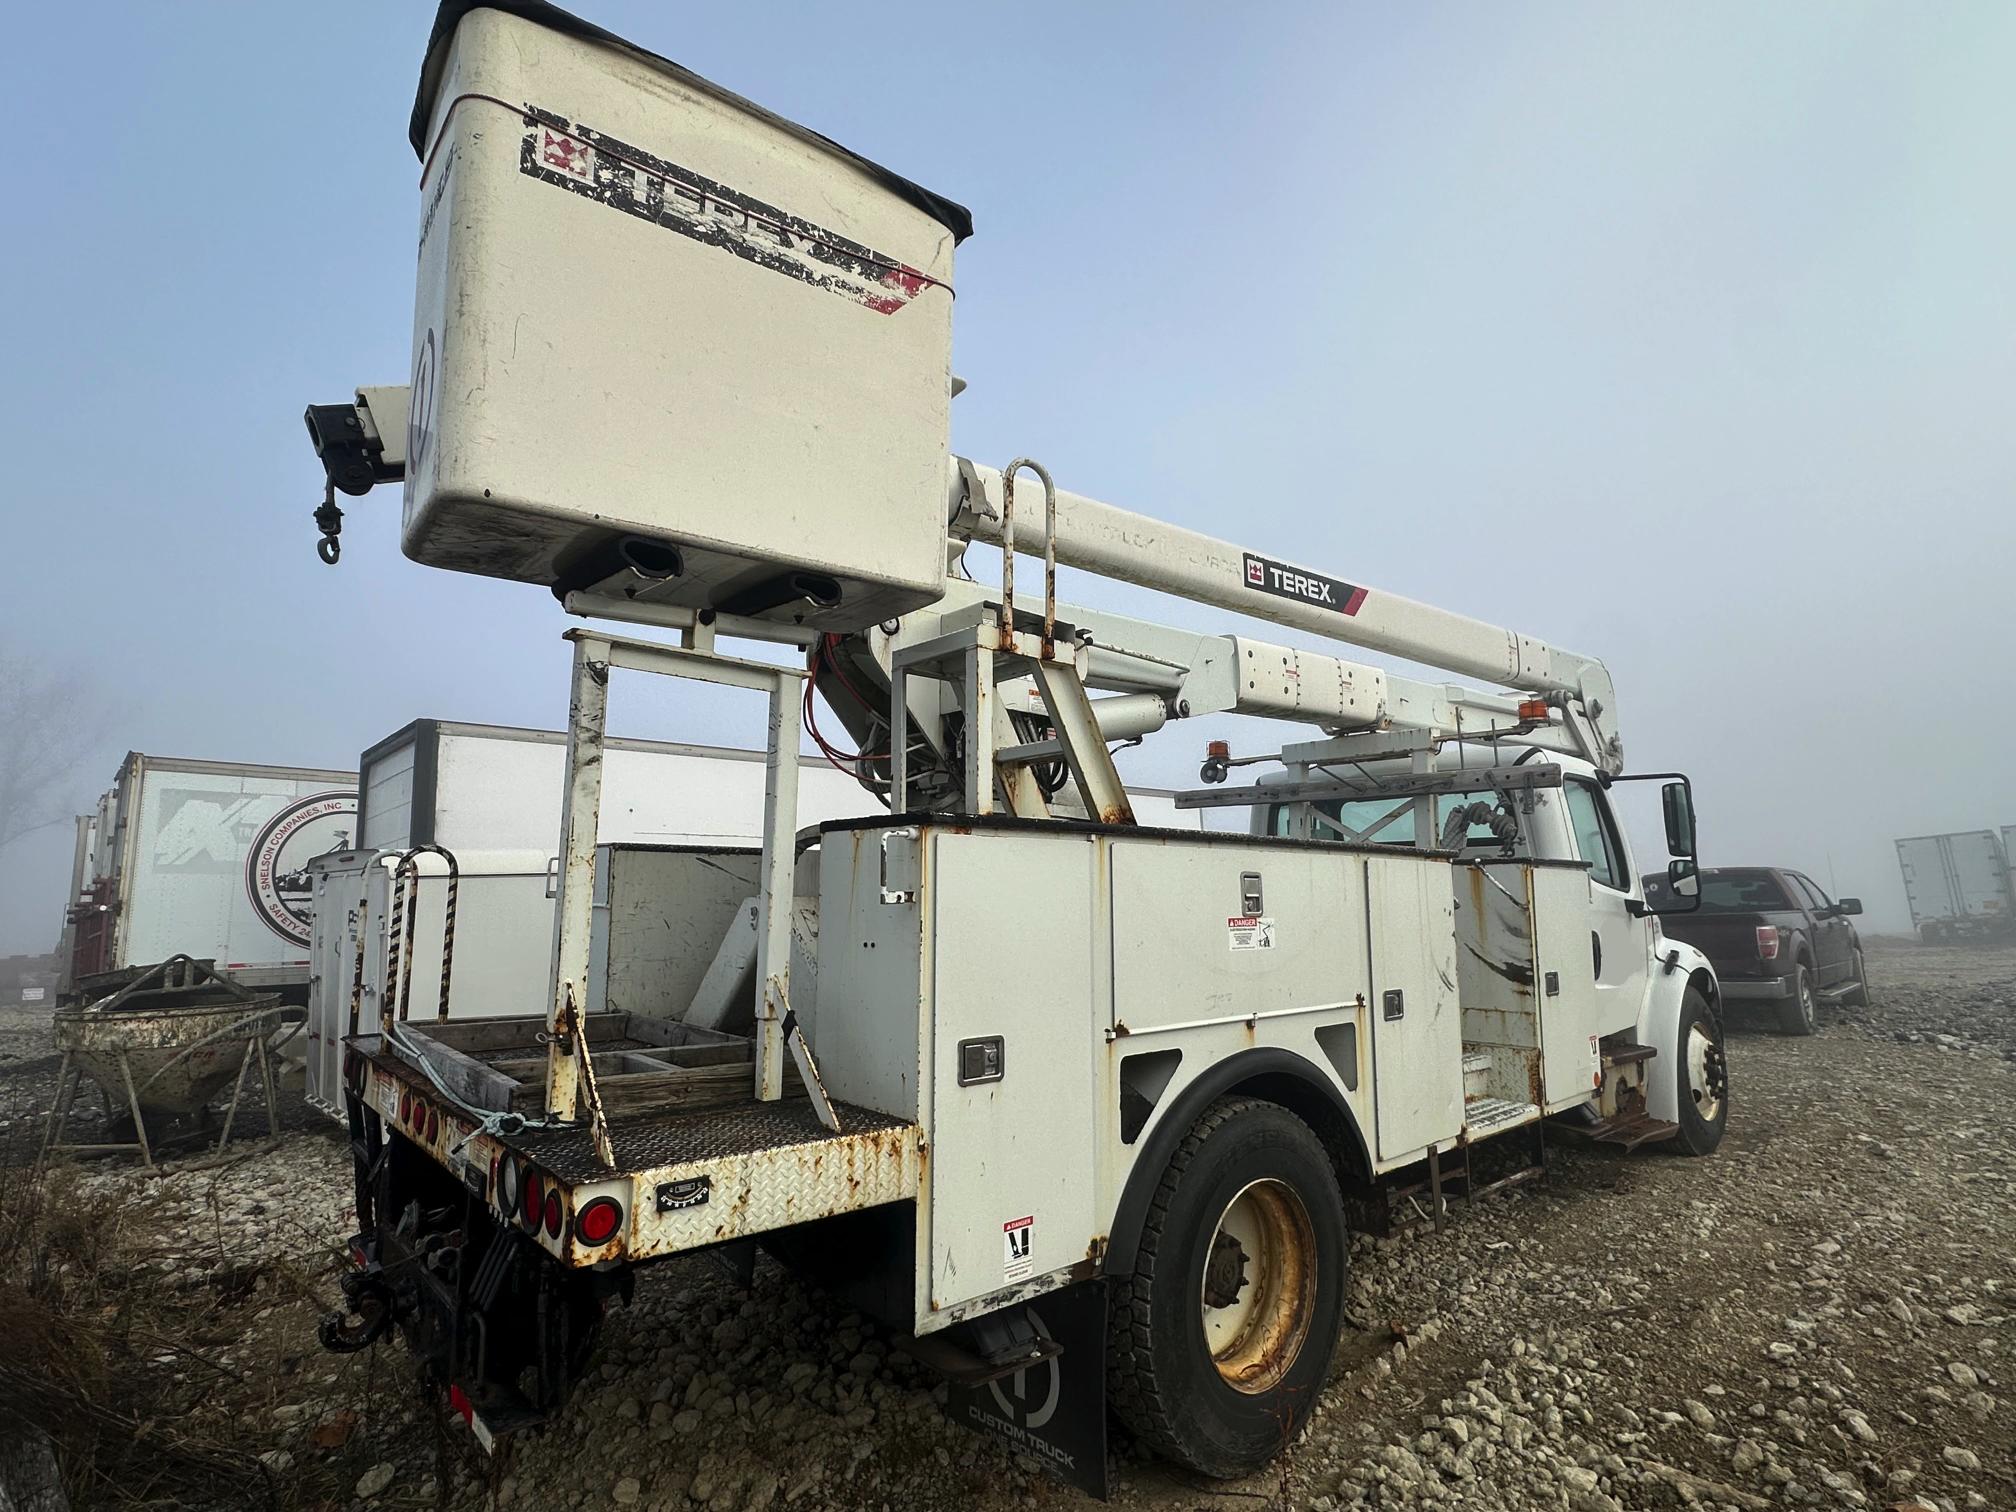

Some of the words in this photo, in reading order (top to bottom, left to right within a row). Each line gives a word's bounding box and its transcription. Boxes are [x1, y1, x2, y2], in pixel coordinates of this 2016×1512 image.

[1269, 566, 1333, 603] TEREX
[260, 846, 276, 891] SNELSON
[270, 806, 323, 846] COMPANIES,
[323, 801, 343, 811] INC
[268, 902, 300, 934] SAFETY
[1011, 1218, 1031, 1229] DANGER
[968, 1405, 1026, 1442] CUSTOM
[1027, 1432, 1076, 1470] TRUCK
[983, 1427, 1009, 1448] ONE
